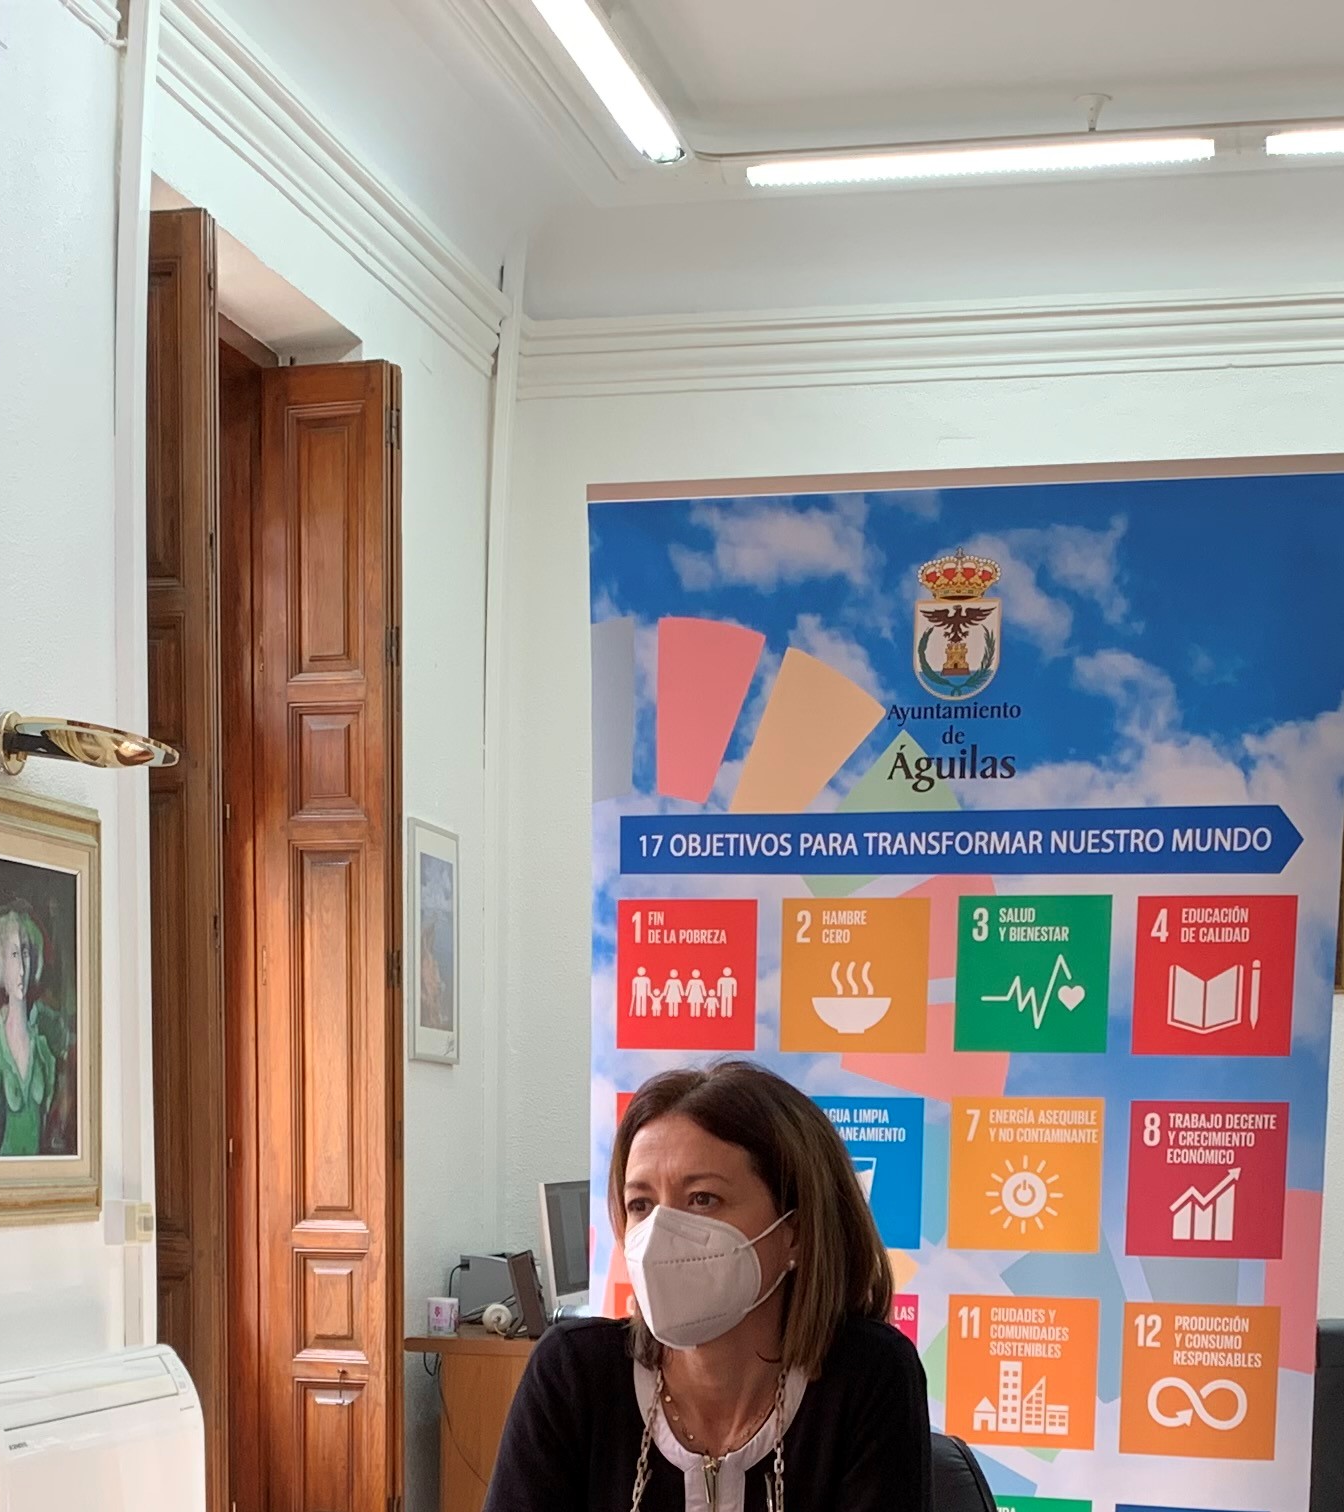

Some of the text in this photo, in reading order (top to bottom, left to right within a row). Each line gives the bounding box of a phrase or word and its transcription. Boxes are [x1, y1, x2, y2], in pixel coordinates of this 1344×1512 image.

[887, 702, 1022, 727] Ayuntamiento
[941, 724, 965, 745] de
[887, 744, 1017, 793] Águilas
[638, 827, 1272, 857] 17 OBJETIVOS PARA TRANSFORMAR NUESTRO MUNDO
[647, 911, 664, 926] FIN
[822, 911, 867, 925] HAMBRE
[999, 908, 1036, 924] SALUD
[1181, 905, 1248, 924] EDUCACIÓN
[631, 911, 643, 944] 1
[796, 910, 811, 944] 2
[972, 907, 989, 942] 3
[1150, 908, 1169, 943] 4
[647, 929, 727, 944] DE LA POBREZA
[821, 929, 850, 944] CERO
[998, 926, 1069, 942] Y BIENESTAR
[1180, 927, 1249, 943] DE CALIDAD
[853, 1109, 890, 1124] LIMPIA
[989, 1107, 1097, 1125] ENERGÍA ASEQUIBLE
[1168, 1113, 1277, 1130] TRABAJO DECENTE
[838, 1127, 906, 1142] ANEAMIENTO
[966, 1109, 981, 1142] 7
[1143, 1112, 1161, 1147] 8
[989, 1128, 1098, 1144] Y NO CONTAMINANTE
[1168, 1131, 1255, 1148] Y CRECIMIENTO
[1166, 1147, 1235, 1165] ECONÓMICO
[958, 1306, 981, 1339] 11
[990, 1307, 1057, 1323] CIUDADES Y
[1174, 1315, 1249, 1333] PRODUCCIÓN
[990, 1325, 1069, 1342] COMUNIDADES
[1134, 1314, 1162, 1348] 12
[989, 1341, 1062, 1359] SOSTENIBLES
[1174, 1334, 1242, 1350] Y CONSUMO
[1173, 1351, 1262, 1368] RESPONSABLES
